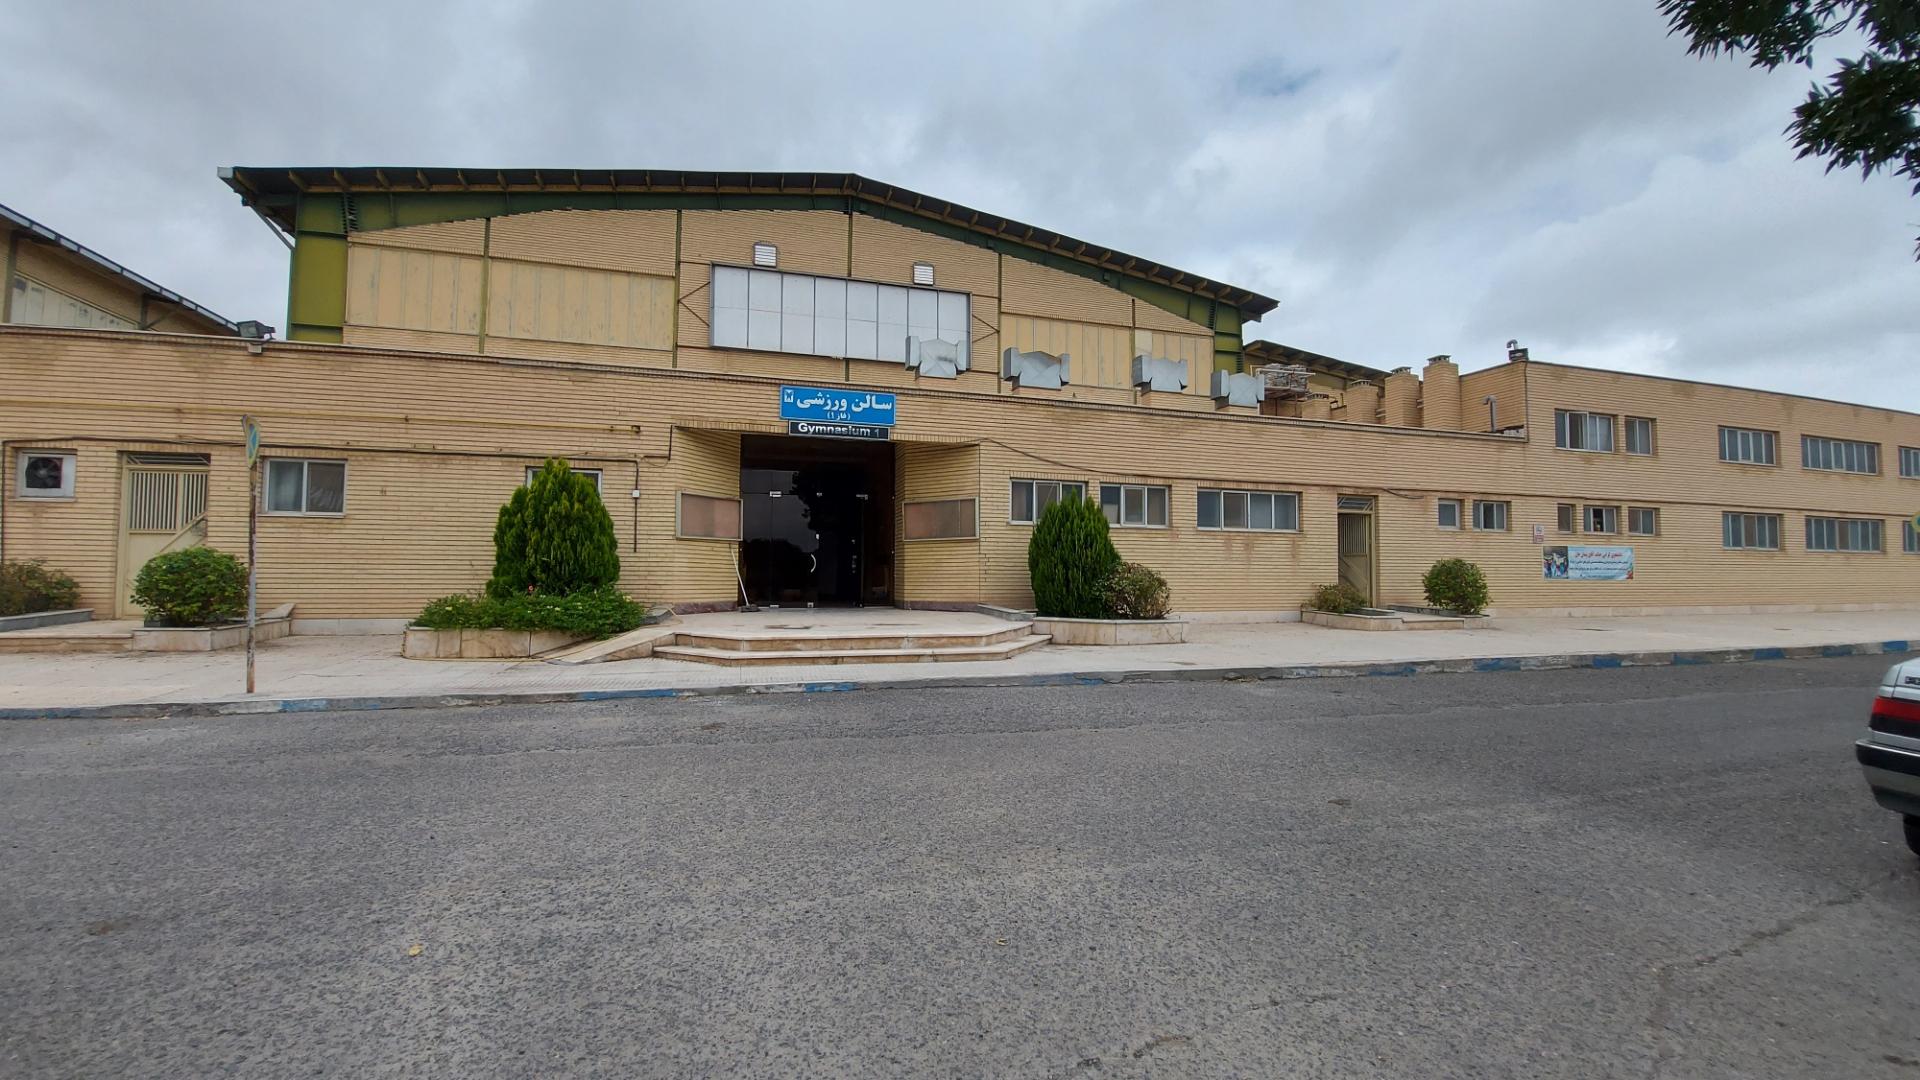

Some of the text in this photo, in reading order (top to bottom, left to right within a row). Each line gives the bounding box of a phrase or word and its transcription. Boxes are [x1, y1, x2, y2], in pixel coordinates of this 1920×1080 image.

[796, 391, 892, 412] سالن ورزشی
[798, 422, 880, 437] Gymnasium 1
